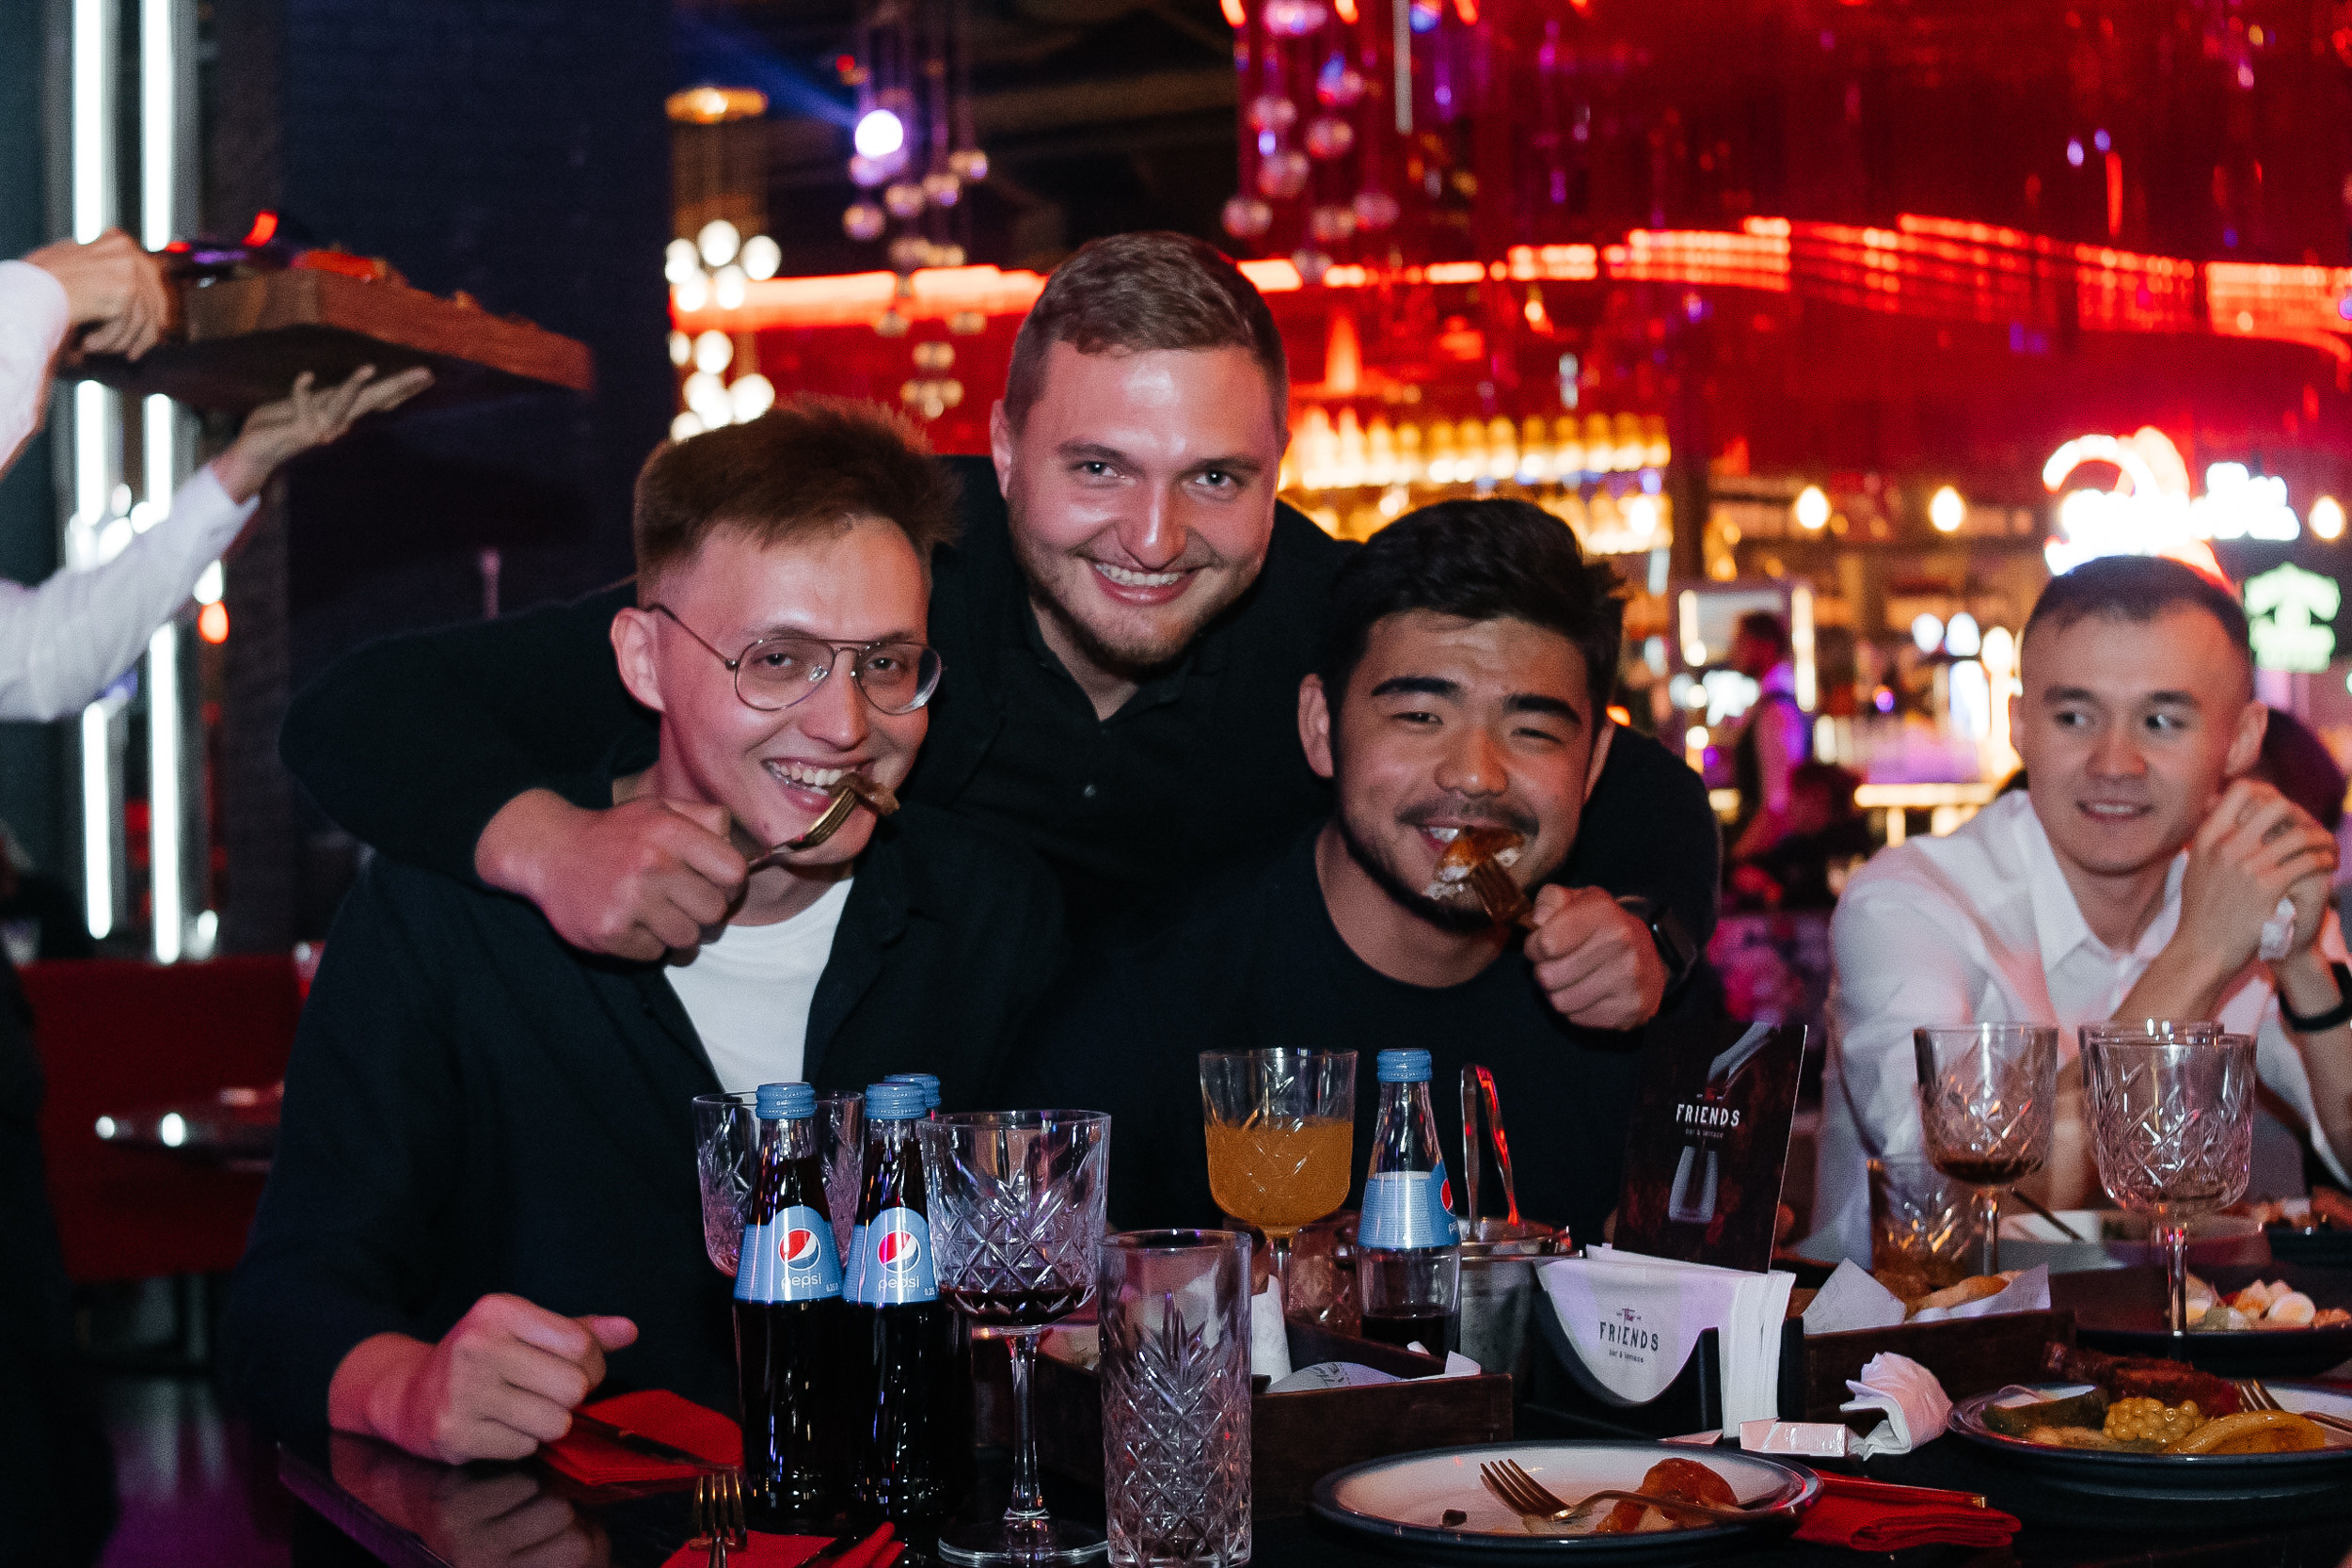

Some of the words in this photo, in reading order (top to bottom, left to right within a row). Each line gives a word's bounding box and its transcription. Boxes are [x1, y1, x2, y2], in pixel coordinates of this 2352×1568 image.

[1676, 1103, 1740, 1127] FRIENDS
[781, 1273, 822, 1290] pepsi
[878, 1275, 920, 1291] pepsi
[1599, 1321, 1659, 1352] FRIENDS
